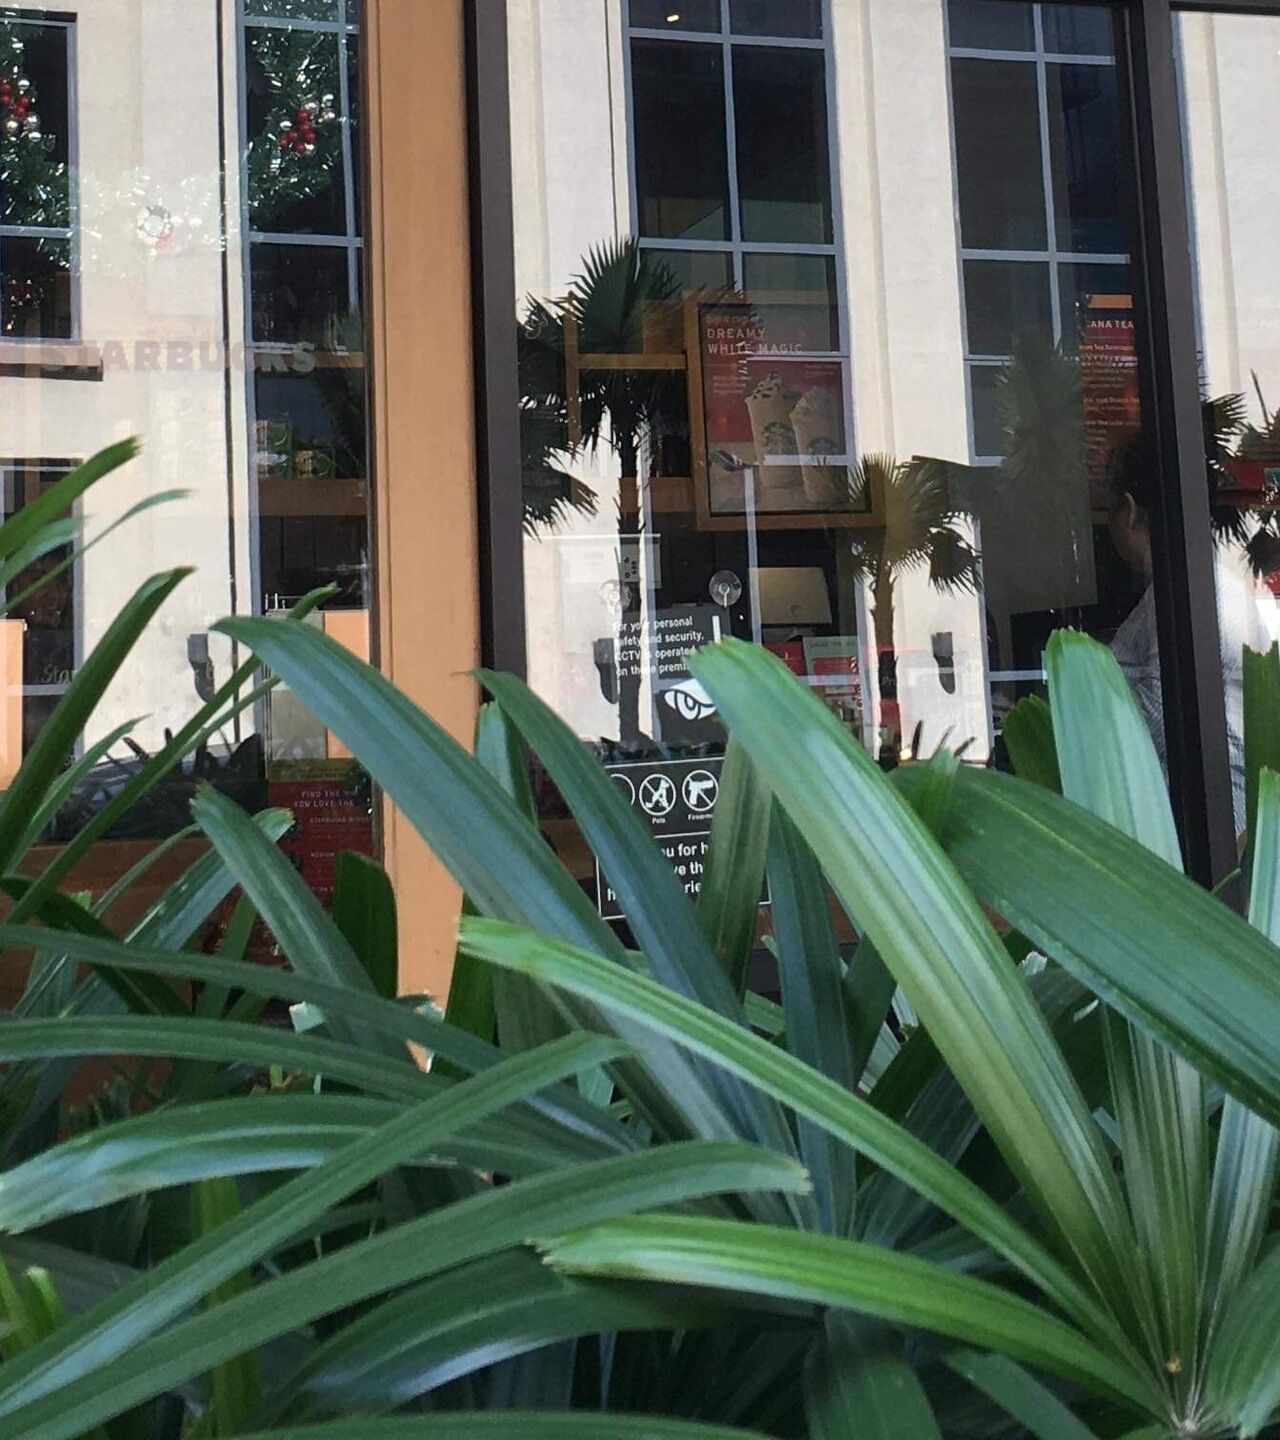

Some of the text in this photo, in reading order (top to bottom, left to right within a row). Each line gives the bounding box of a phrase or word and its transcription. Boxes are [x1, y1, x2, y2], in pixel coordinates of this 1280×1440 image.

[1087, 320, 1134, 329] ANA TEA
[707, 328, 766, 339] DREAMY
[707, 343, 803, 355] WHITE MAGIC
[39, 340, 317, 373] STARBUCKS
[630, 620, 650, 633] yor
[654, 616, 693, 631] personal
[614, 635, 641, 647] afety
[665, 630, 704, 642] security.
[615, 650, 641, 661] CCTV
[613, 661, 690, 677] on the premi
[301, 790, 321, 799] FIND
[294, 800, 311, 809] YOU
[313, 800, 333, 808] LOVE
[652, 816, 666, 825] Pets
[677, 843, 699, 857] for
